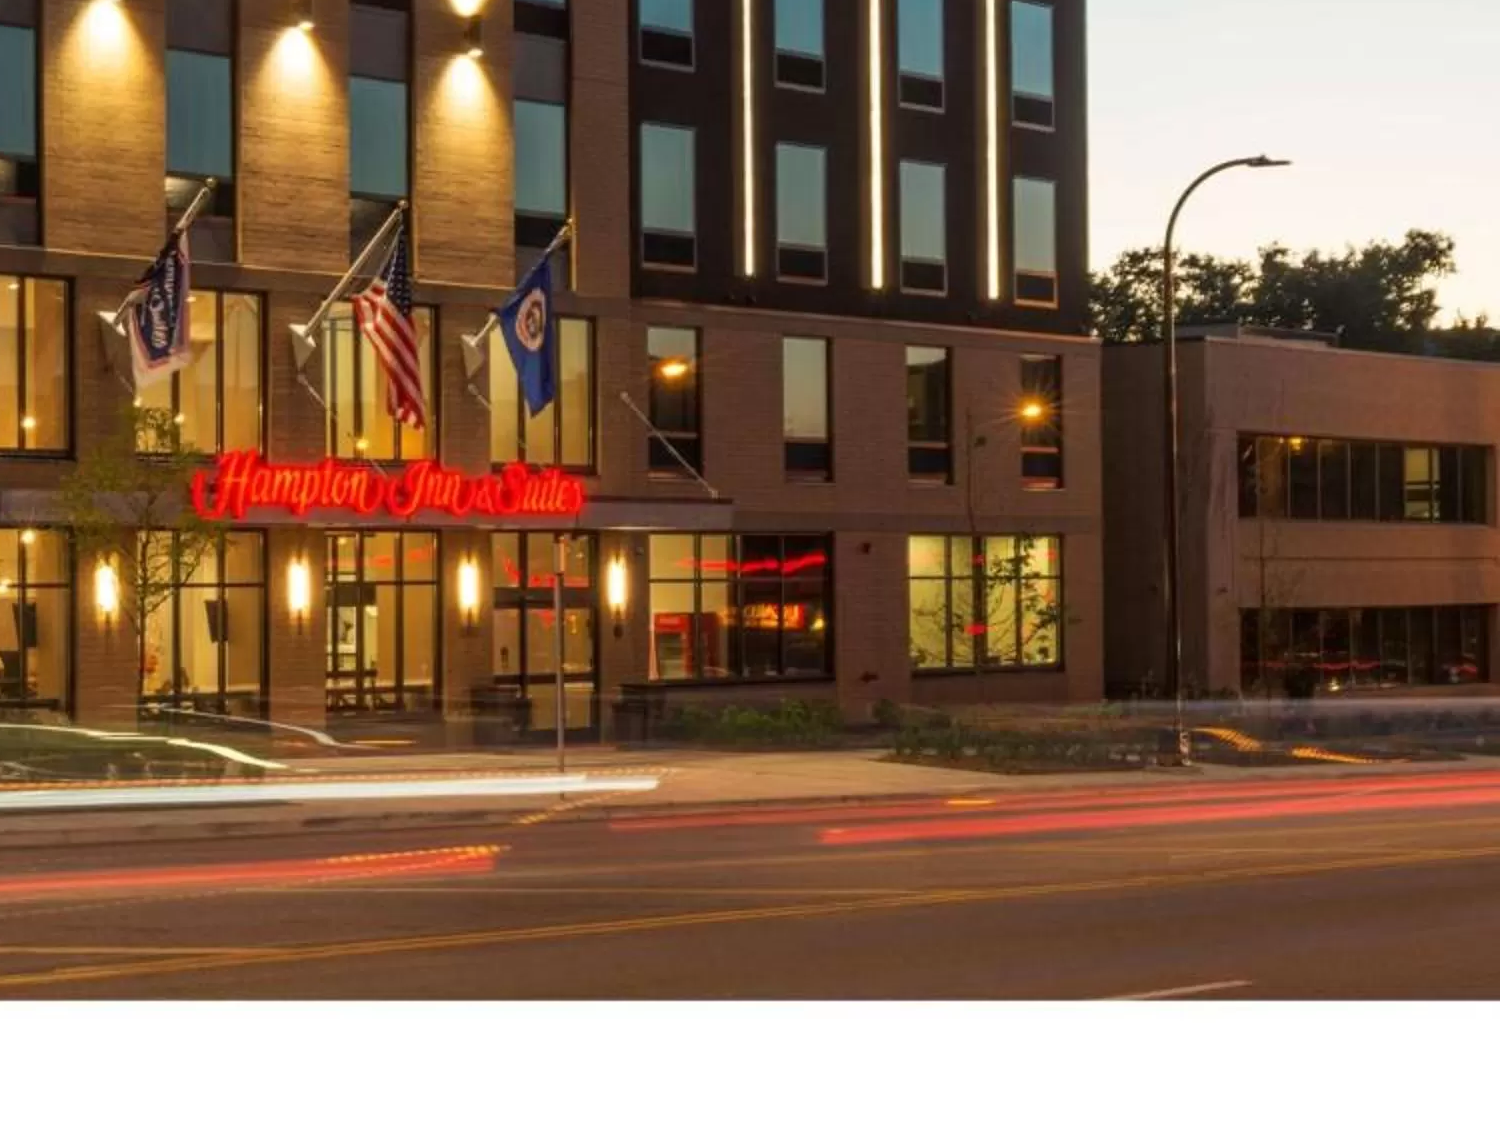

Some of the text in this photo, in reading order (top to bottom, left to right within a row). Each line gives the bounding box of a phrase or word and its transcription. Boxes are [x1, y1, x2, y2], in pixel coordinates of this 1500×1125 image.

[191, 449, 585, 519] Hampton Inn & Suites
